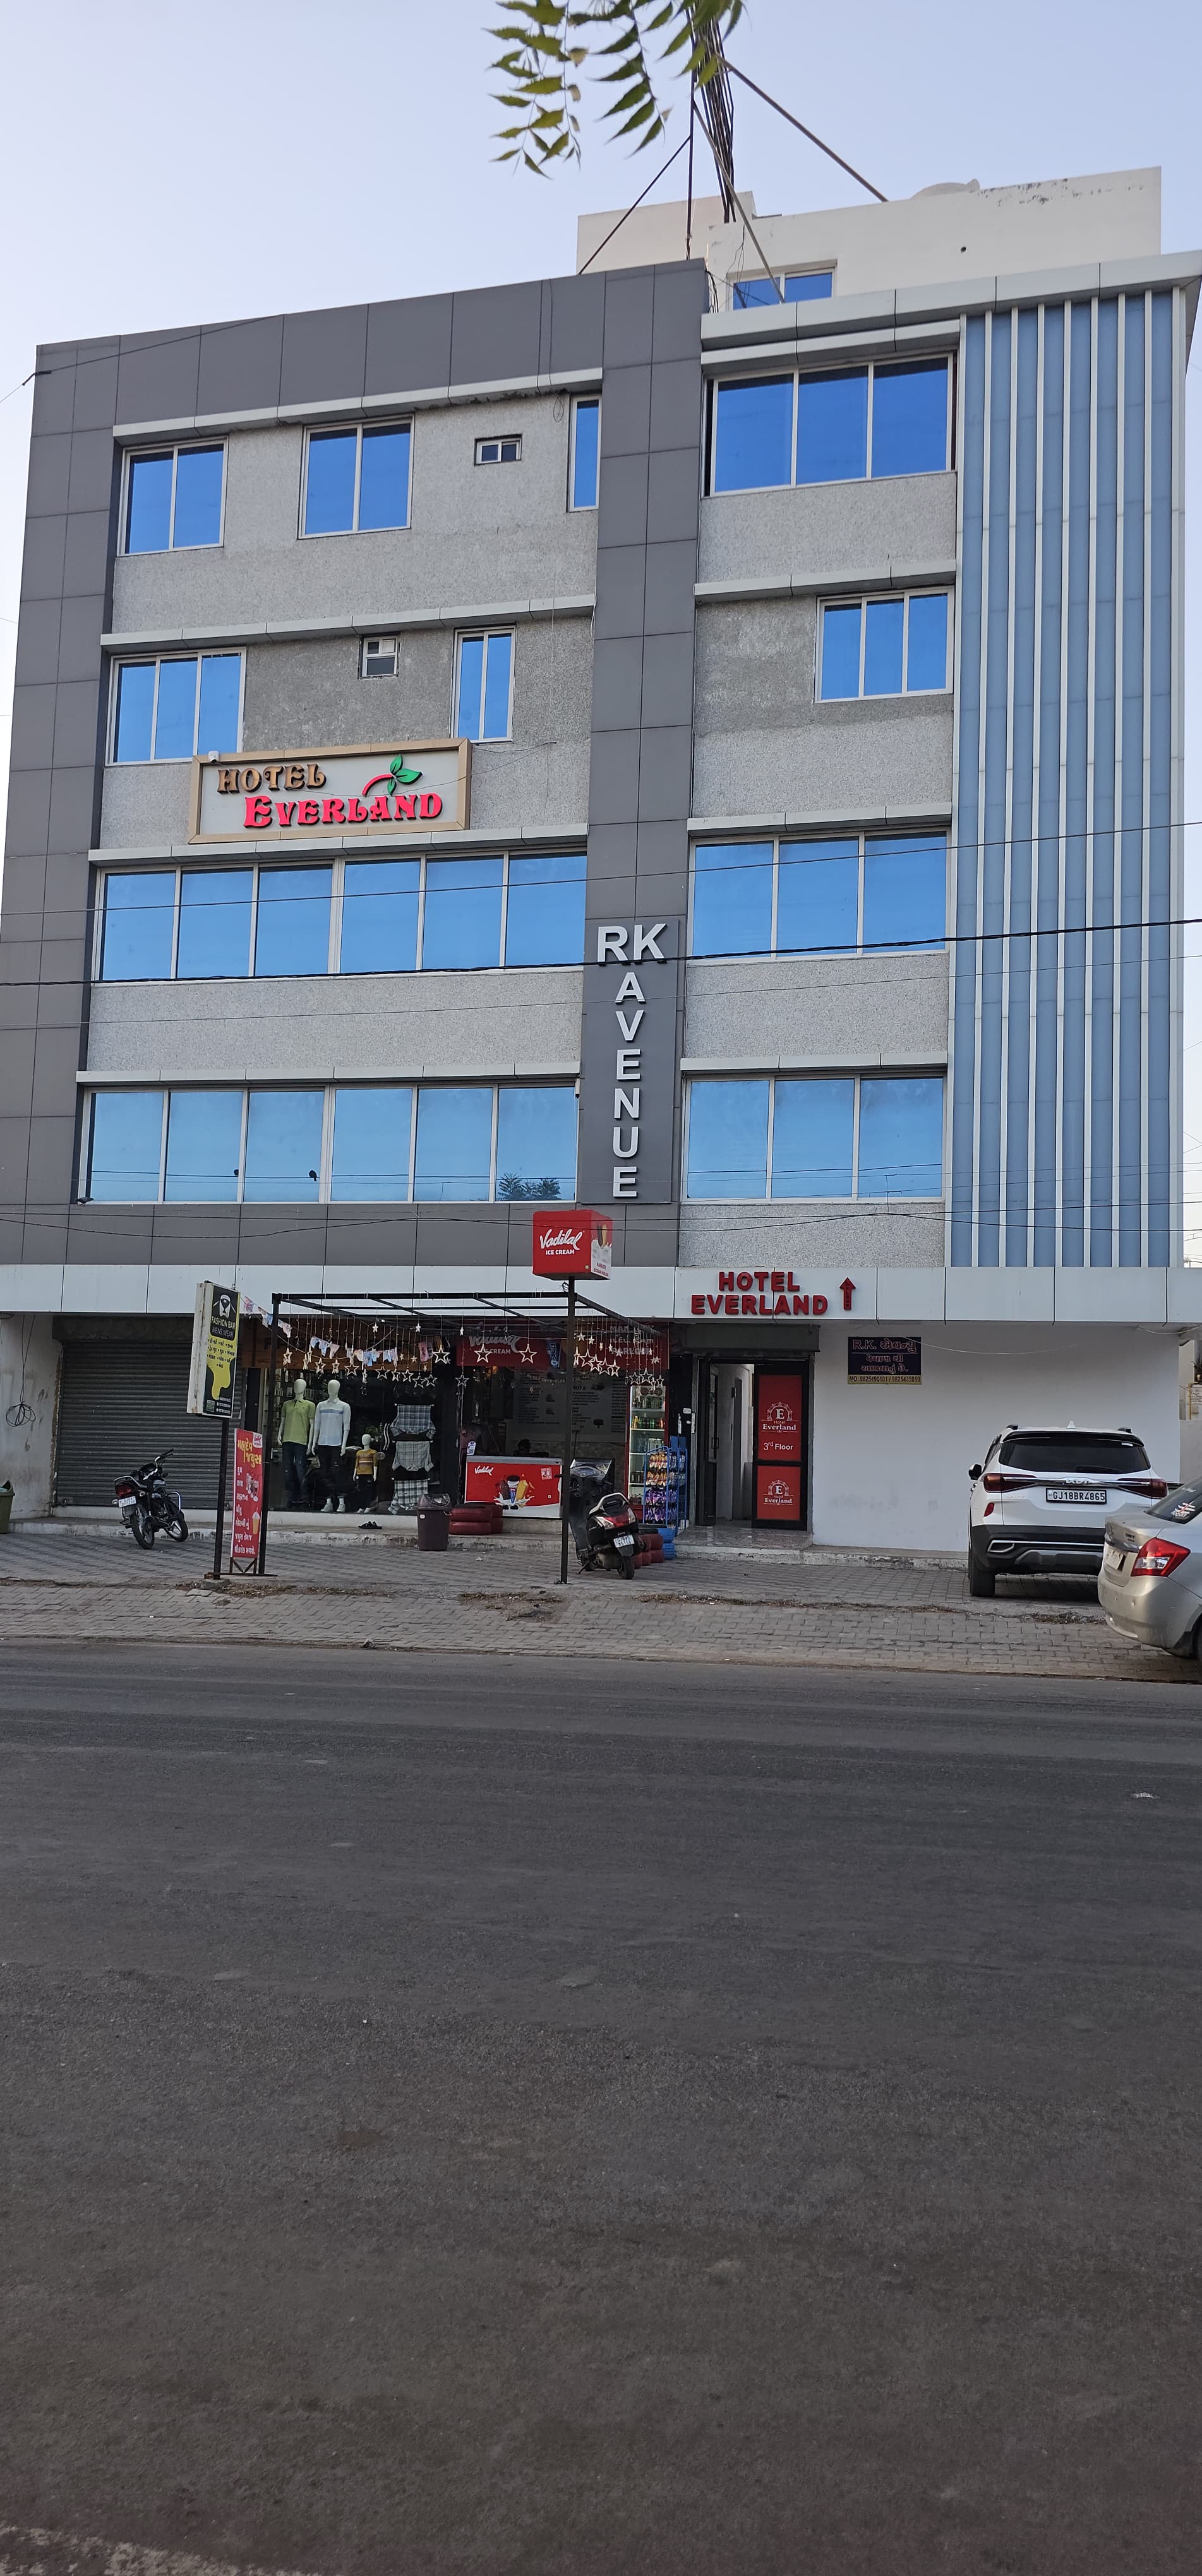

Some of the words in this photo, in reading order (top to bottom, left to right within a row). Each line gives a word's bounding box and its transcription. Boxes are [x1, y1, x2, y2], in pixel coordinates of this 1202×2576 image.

[217, 763, 327, 794] HOTEL
[244, 793, 443, 828] EVERLAND
[597, 923, 667, 965] RK
[613, 971, 646, 1198] AVENUE
[539, 1229, 583, 1250] Vadilal
[719, 1272, 800, 1291] HOTEL
[691, 1295, 828, 1315] EVERLAND
[212, 1316, 227, 1328] FASHION
[212, 1326, 222, 1335] MENS
[223, 1329, 234, 1337] WEAR
[853, 1339, 877, 1350] R.K.
[776, 1409, 784, 1419] E
[474, 1465, 494, 1476] Vadilal
[1053, 1491, 1105, 1501] GJ18BR4865
